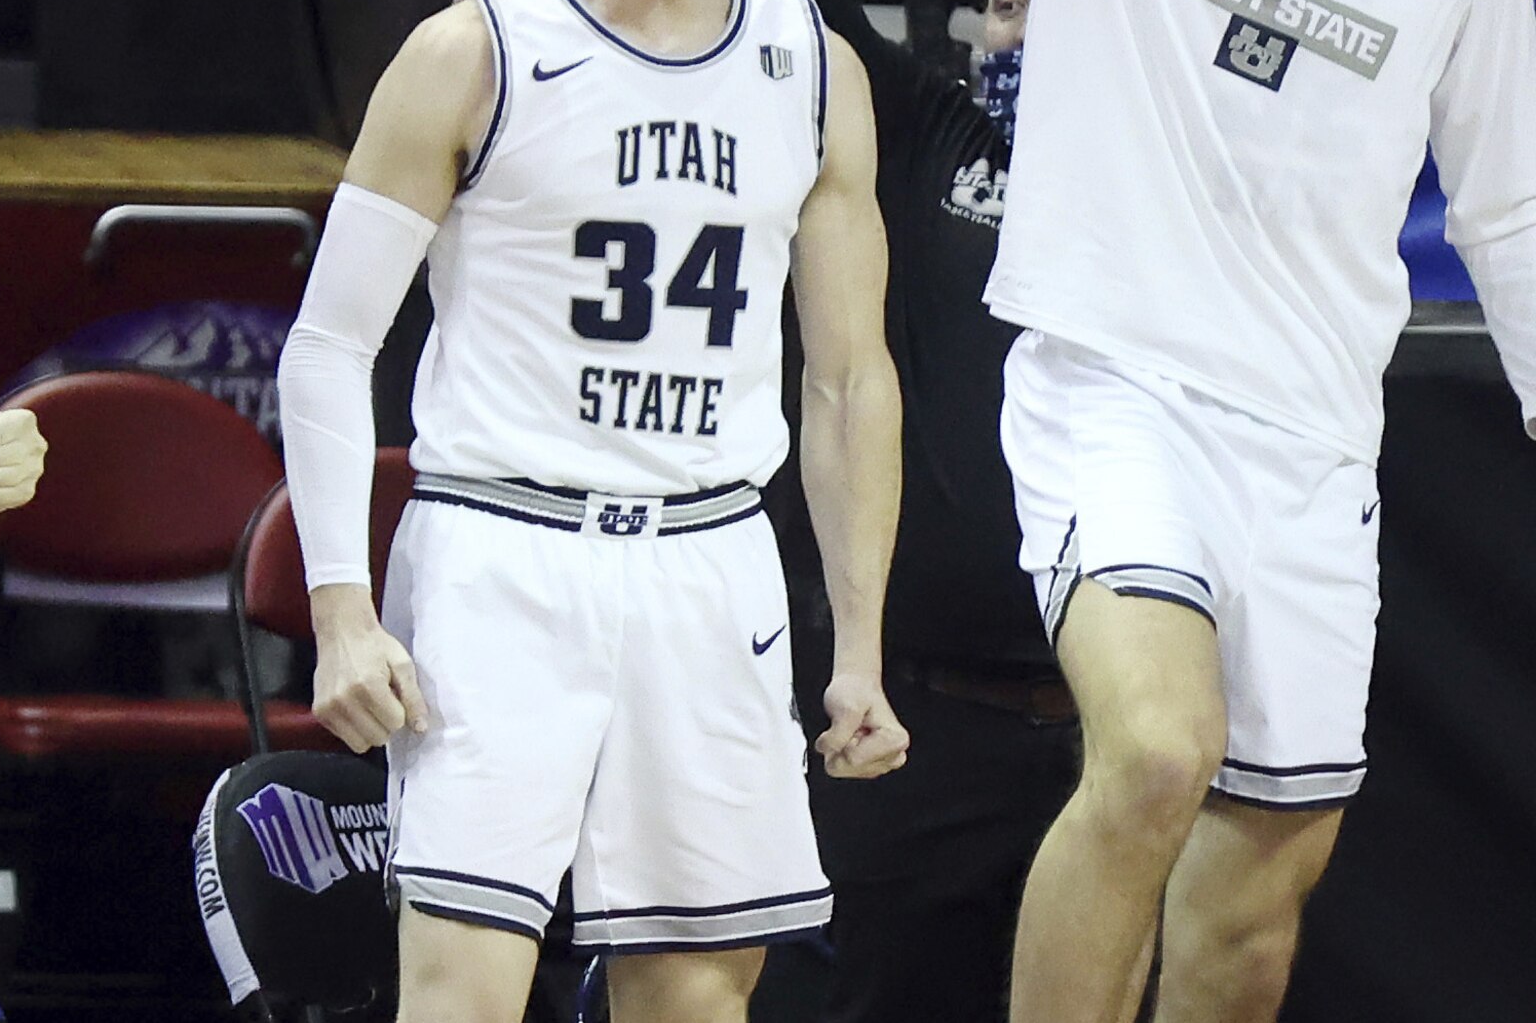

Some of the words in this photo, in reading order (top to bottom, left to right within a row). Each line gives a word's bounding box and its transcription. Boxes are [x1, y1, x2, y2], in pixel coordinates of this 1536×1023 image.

[616, 119, 739, 196] UTAH
[569, 219, 748, 350] 34
[579, 366, 724, 437] STATE
